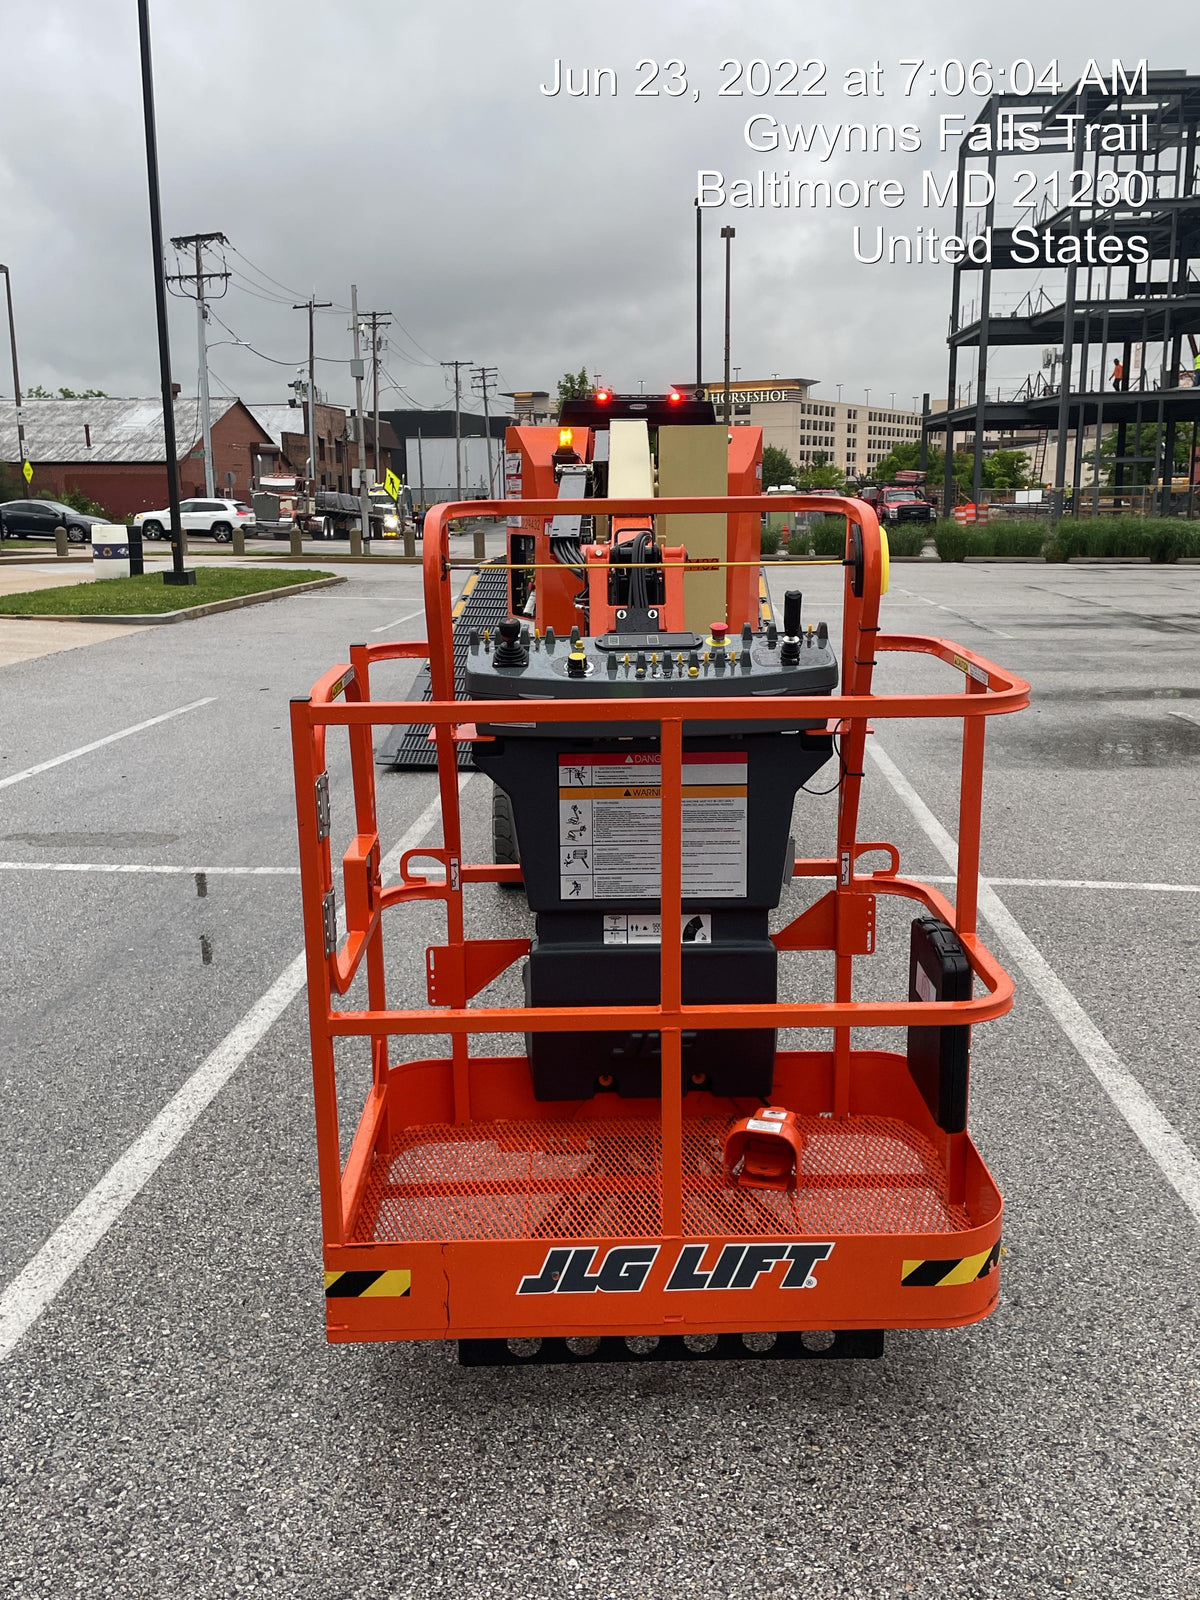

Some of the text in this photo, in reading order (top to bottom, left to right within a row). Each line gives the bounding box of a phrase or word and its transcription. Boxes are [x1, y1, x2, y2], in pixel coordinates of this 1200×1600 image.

[711, 390, 788, 404] HORSESHOE
[634, 754, 661, 763] DANG
[633, 788, 661, 797] WARNI
[515, 1242, 835, 1295] JLG LIFT
